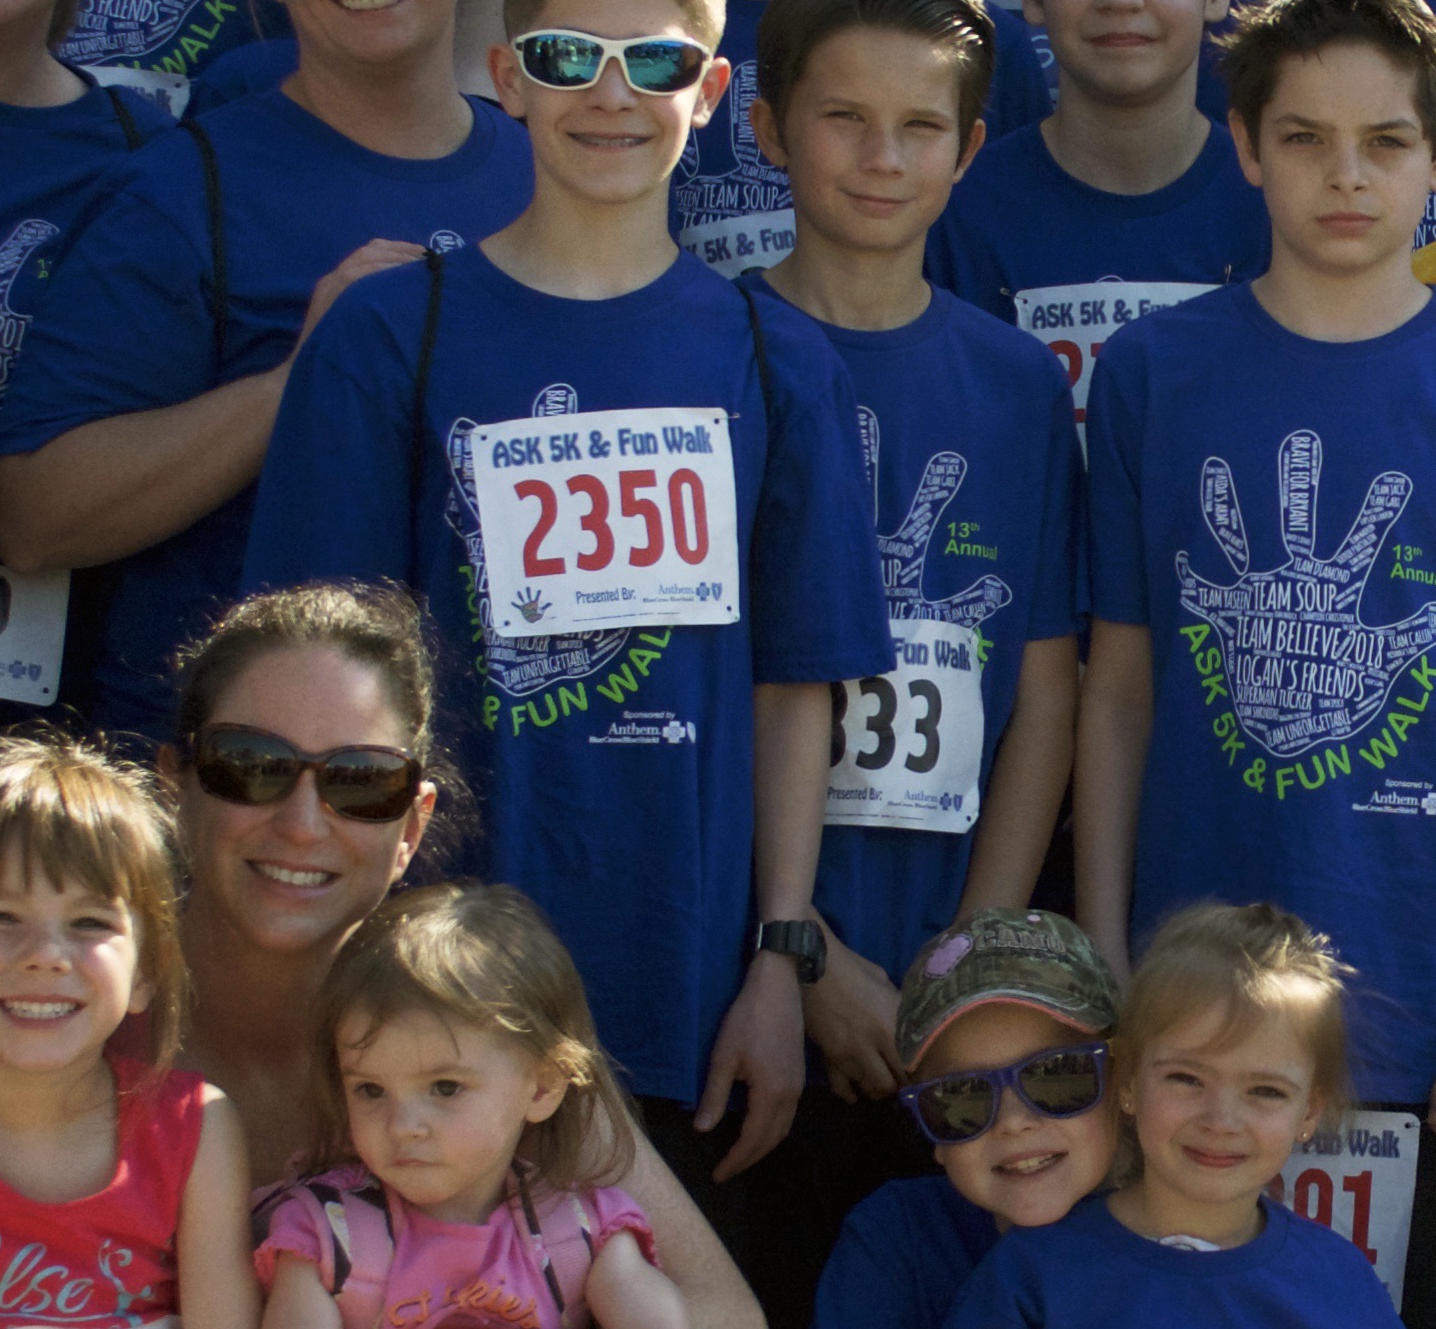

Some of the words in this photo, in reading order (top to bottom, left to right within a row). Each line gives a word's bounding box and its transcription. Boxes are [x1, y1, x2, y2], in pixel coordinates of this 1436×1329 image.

[759, 228, 796, 253] Fun
[1032, 302, 1074, 329] ASK
[1080, 299, 1106, 326] 5K
[492, 435, 545, 469] ASK
[548, 432, 582, 463] 5K
[589, 429, 612, 458] &
[619, 426, 659, 458] Fun
[662, 425, 713, 455] Walk
[513, 468, 710, 578] 2350
[945, 539, 998, 560] Annual
[576, 588, 618, 605] Presented
[1253, 582, 1291, 610] TEAM
[1295, 583, 1337, 612] SOUP
[892, 636, 929, 666] Fun
[935, 639, 972, 670] Walk
[1236, 617, 1273, 651] TEAM
[1276, 620, 1342, 660] BELIEVE
[1343, 630, 1384, 669] 2018
[1236, 654, 1299, 690] LOGAN'S
[1302, 662, 1366, 702] FRIENDS
[511, 681, 589, 737] FUN
[1179, 623, 1228, 706] ASK
[1274, 743, 1352, 800] FUN
[608, 722, 661, 736] Anthem
[1370, 790, 1418, 807] Anthem
[1347, 1129, 1400, 1159] Walk
